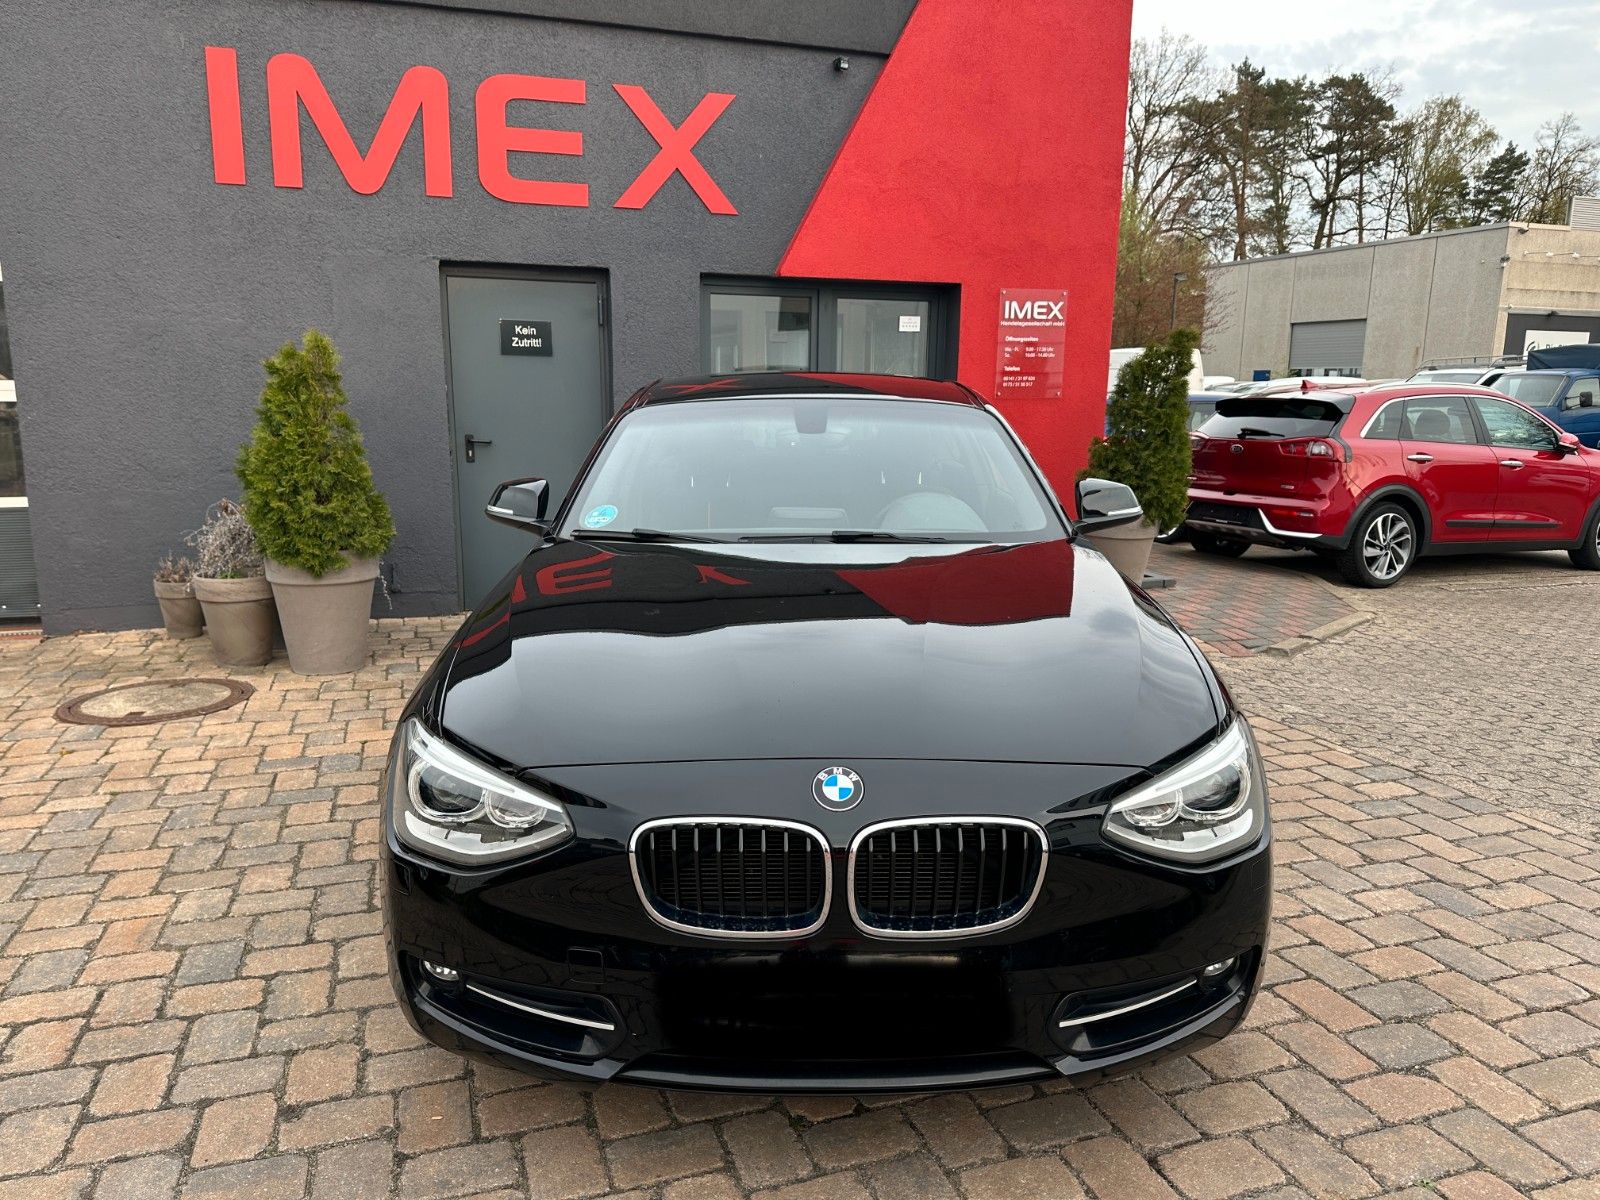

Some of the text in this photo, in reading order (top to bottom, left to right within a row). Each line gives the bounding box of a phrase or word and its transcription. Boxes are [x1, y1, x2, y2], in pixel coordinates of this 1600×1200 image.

[205, 46, 738, 216] IMEX
[1004, 300, 1064, 319] IMEX
[514, 325, 537, 335] Kein
[511, 337, 542, 348] Zutritt!
[816, 767, 860, 782] BMW
